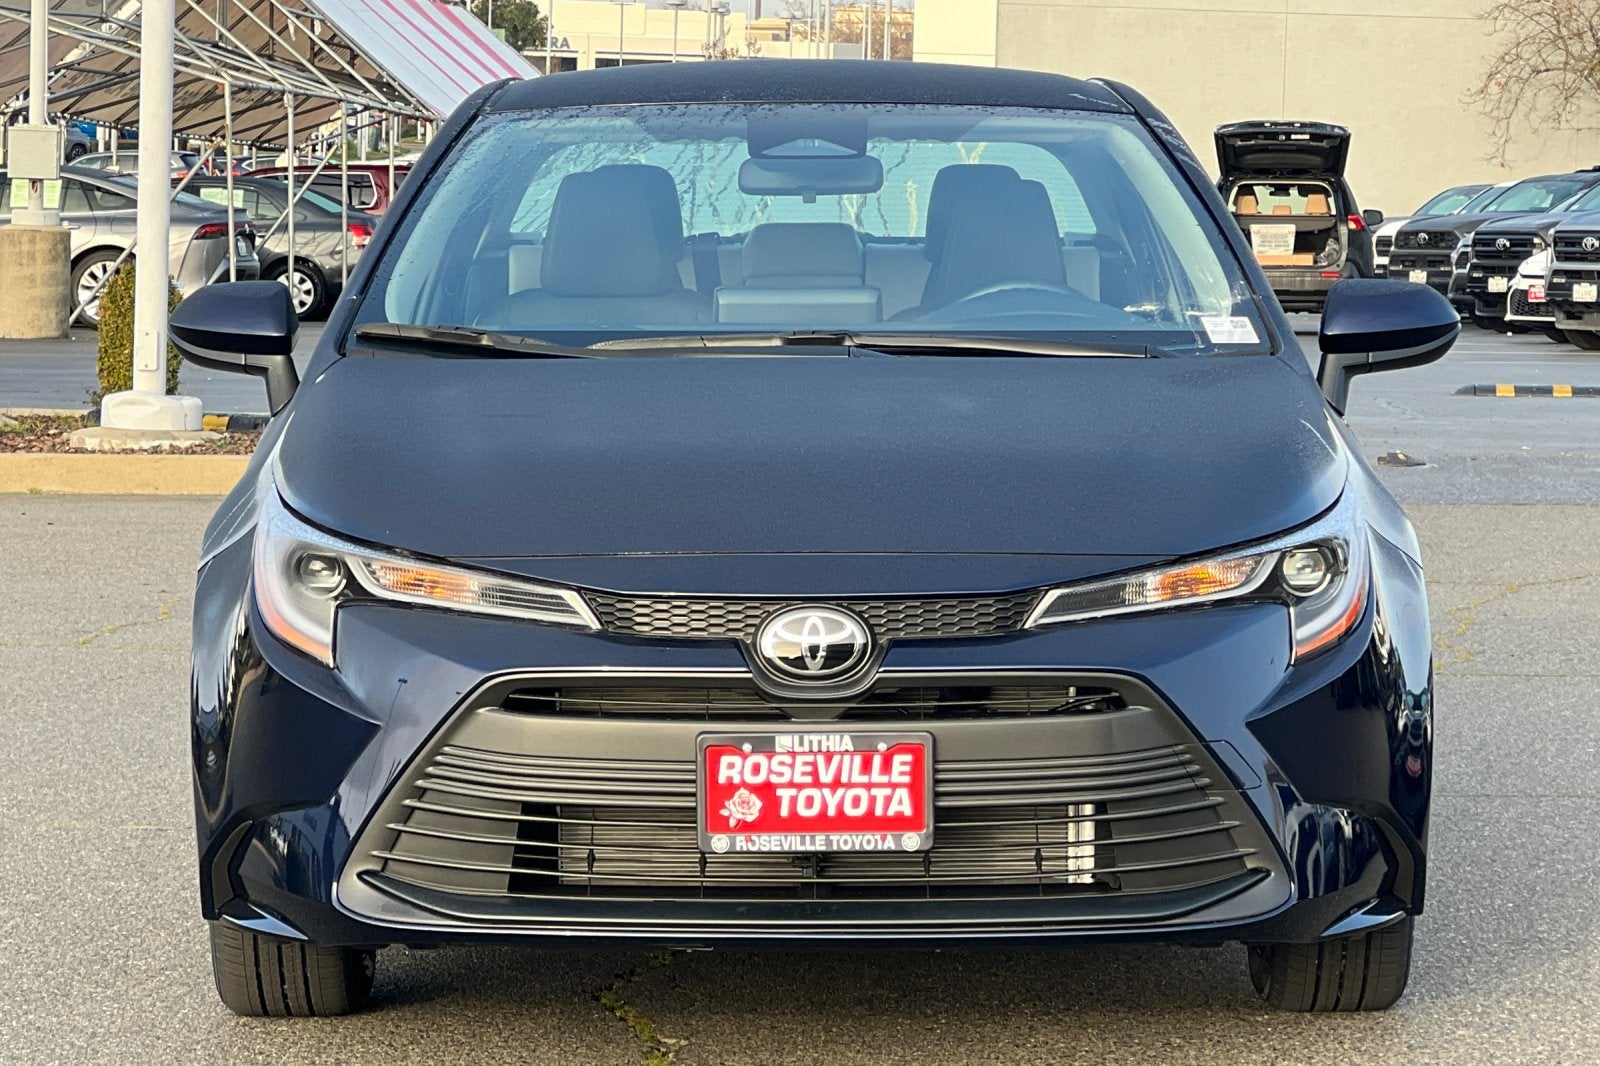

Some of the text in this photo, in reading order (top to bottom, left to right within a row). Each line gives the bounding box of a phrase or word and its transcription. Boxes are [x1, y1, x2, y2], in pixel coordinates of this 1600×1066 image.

[793, 735, 854, 752] LITHIA
[717, 754, 913, 784] ROSEVILLE
[775, 787, 913, 817] TOYOTA
[735, 834, 896, 851] ROSEVILLE TOYOTA
